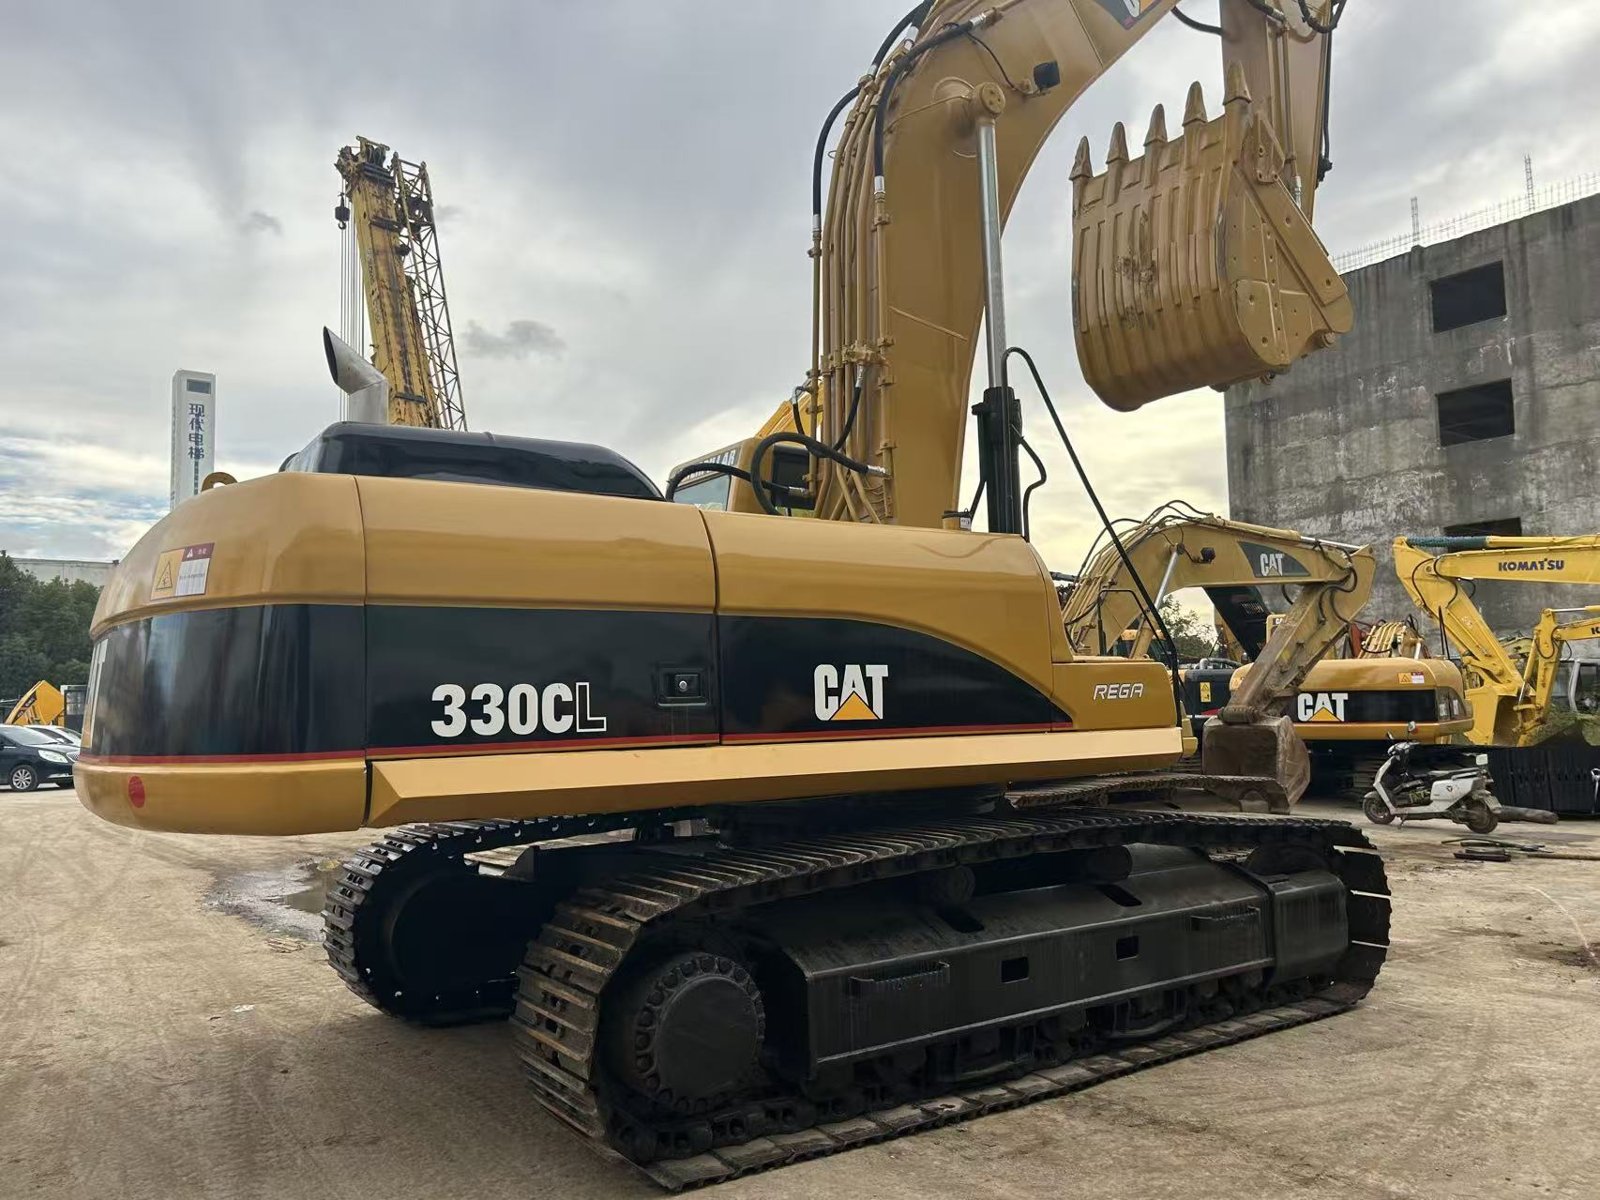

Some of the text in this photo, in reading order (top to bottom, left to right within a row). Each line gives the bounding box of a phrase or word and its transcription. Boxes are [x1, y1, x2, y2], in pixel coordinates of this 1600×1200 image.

[1260, 553, 1284, 577] CAT
[1498, 558, 1564, 572] KOMATSU
[814, 664, 888, 721] CAT
[1093, 683, 1144, 700] REGA
[431, 682, 607, 738] 330CL
[1297, 693, 1349, 722] CAT
